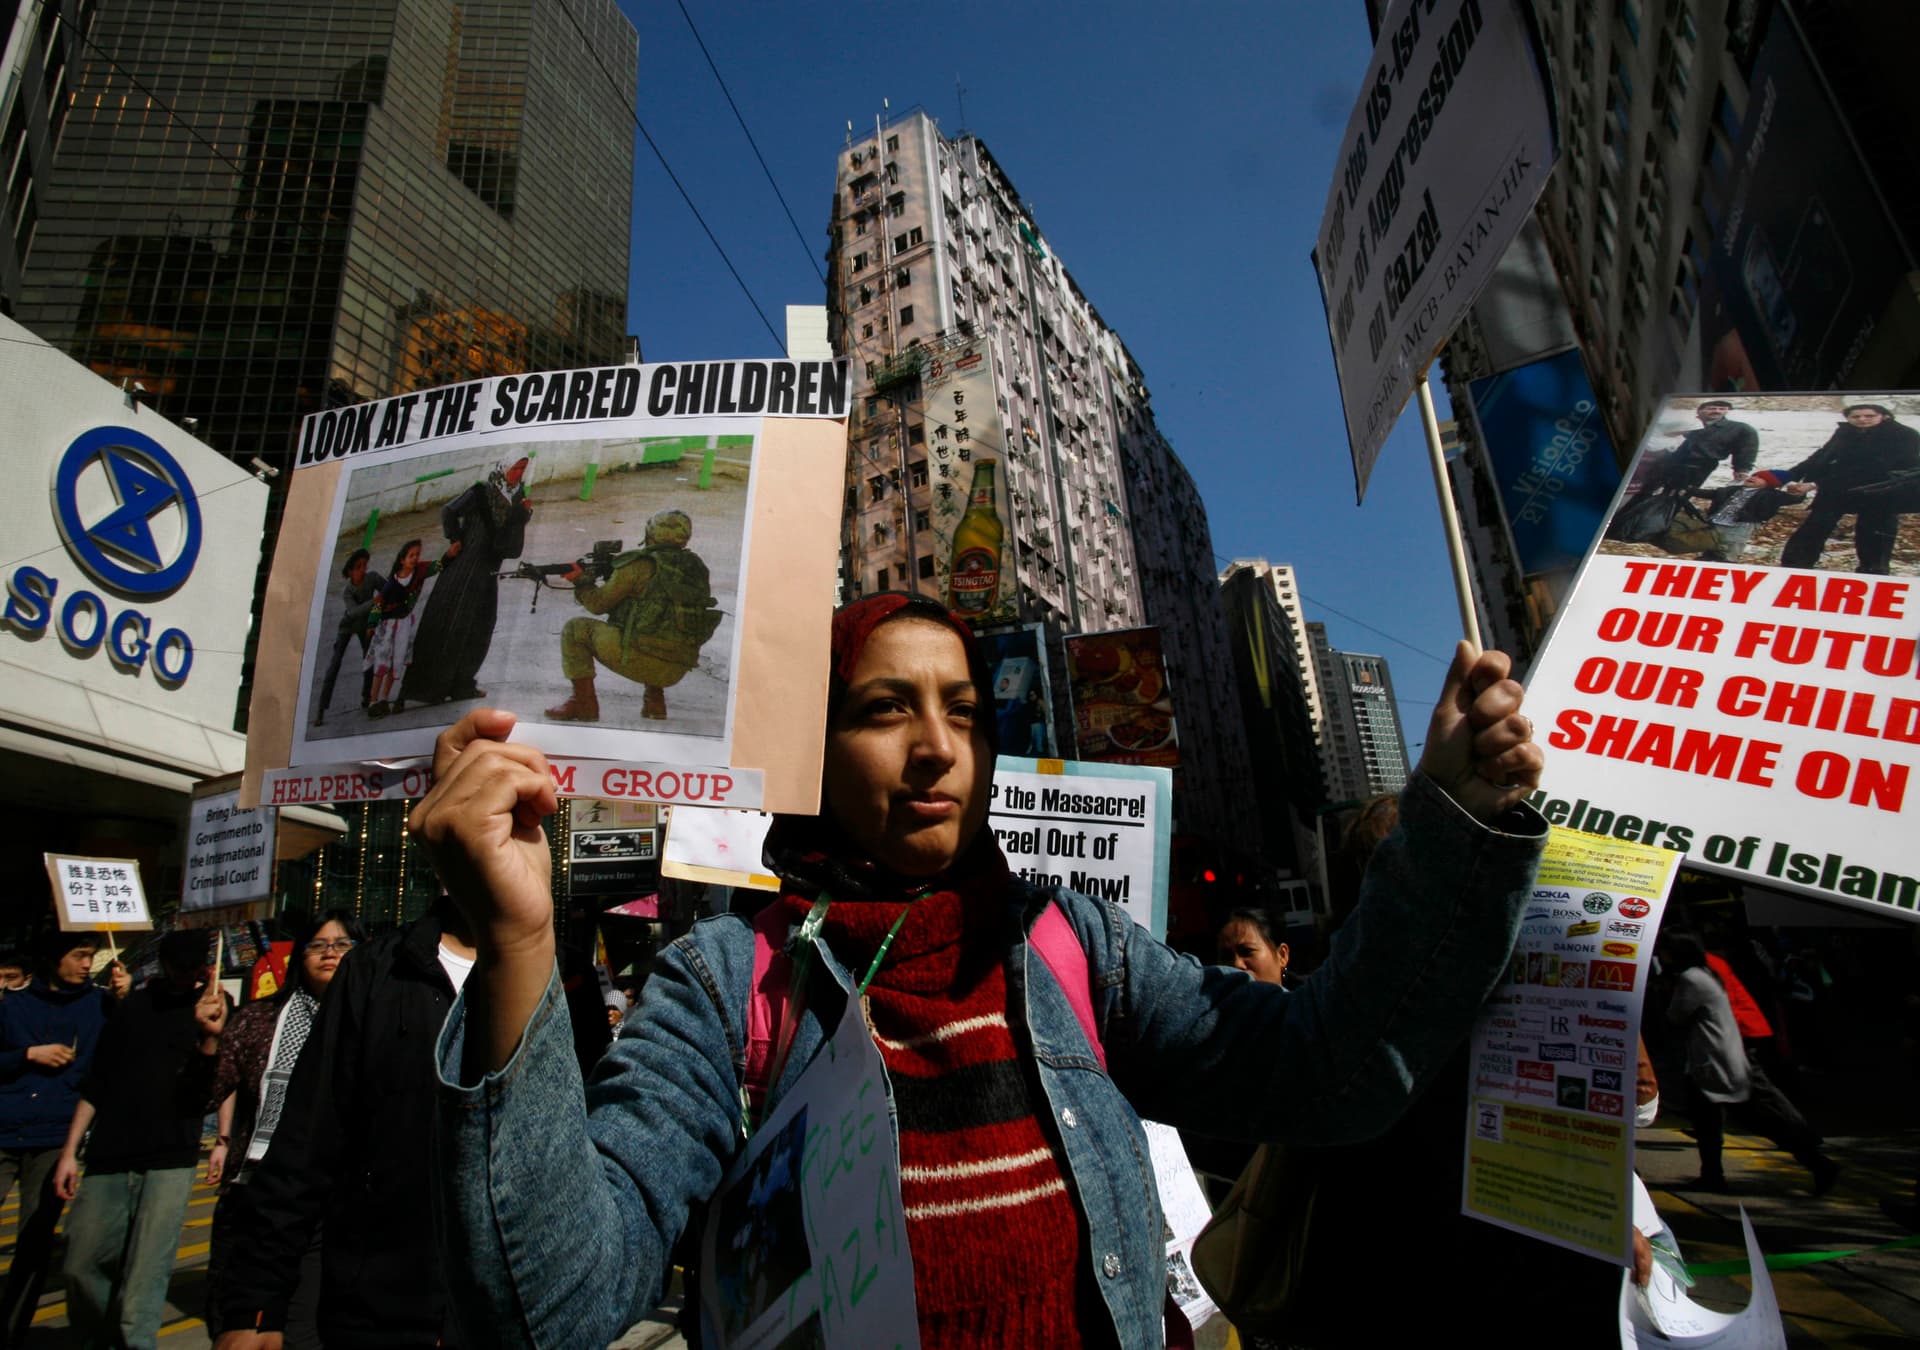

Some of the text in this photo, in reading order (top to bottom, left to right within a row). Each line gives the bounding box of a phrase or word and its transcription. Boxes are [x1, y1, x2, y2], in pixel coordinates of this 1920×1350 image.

[1354, 226, 1369, 293] of
[1368, 0, 1483, 254] Aggression
[1345, 131, 1367, 210] the
[1443, 147, 1531, 290] BAYAN-HK
[1369, 187, 1442, 363] on Gaza!
[300, 361, 847, 464] LOOK AT THE SCARED CHILDREN
[1512, 399, 1591, 494] VisionPro
[1521, 427, 1598, 525] 2110 5600
[953, 575, 994, 587] TSINGTAO
[1623, 561, 1909, 620] THEY ARE
[4, 566, 194, 685] SOGO
[1597, 607, 1920, 680] OUR FUTU
[1573, 656, 1704, 709] OUR
[1548, 709, 1910, 813] SHAME ON
[273, 769, 383, 803] HELPERS
[602, 770, 733, 800] GROUP
[1004, 785, 1036, 811] the
[1041, 788, 1146, 818] Massacre!
[206, 807, 229, 822] Bring
[195, 823, 262, 846] Government to
[1046, 828, 1087, 858] Out
[1093, 832, 1119, 860] of
[190, 841, 265, 868] the International
[1703, 834, 1761, 870] of
[68, 864, 127, 881] 誰是恐怖
[69, 881, 132, 897] 份子 如今
[190, 865, 259, 890] Criminal Court!
[1070, 870, 1130, 903] Now!
[1552, 908, 1582, 917] BOSS
[1553, 943, 1596, 953] DANONE
